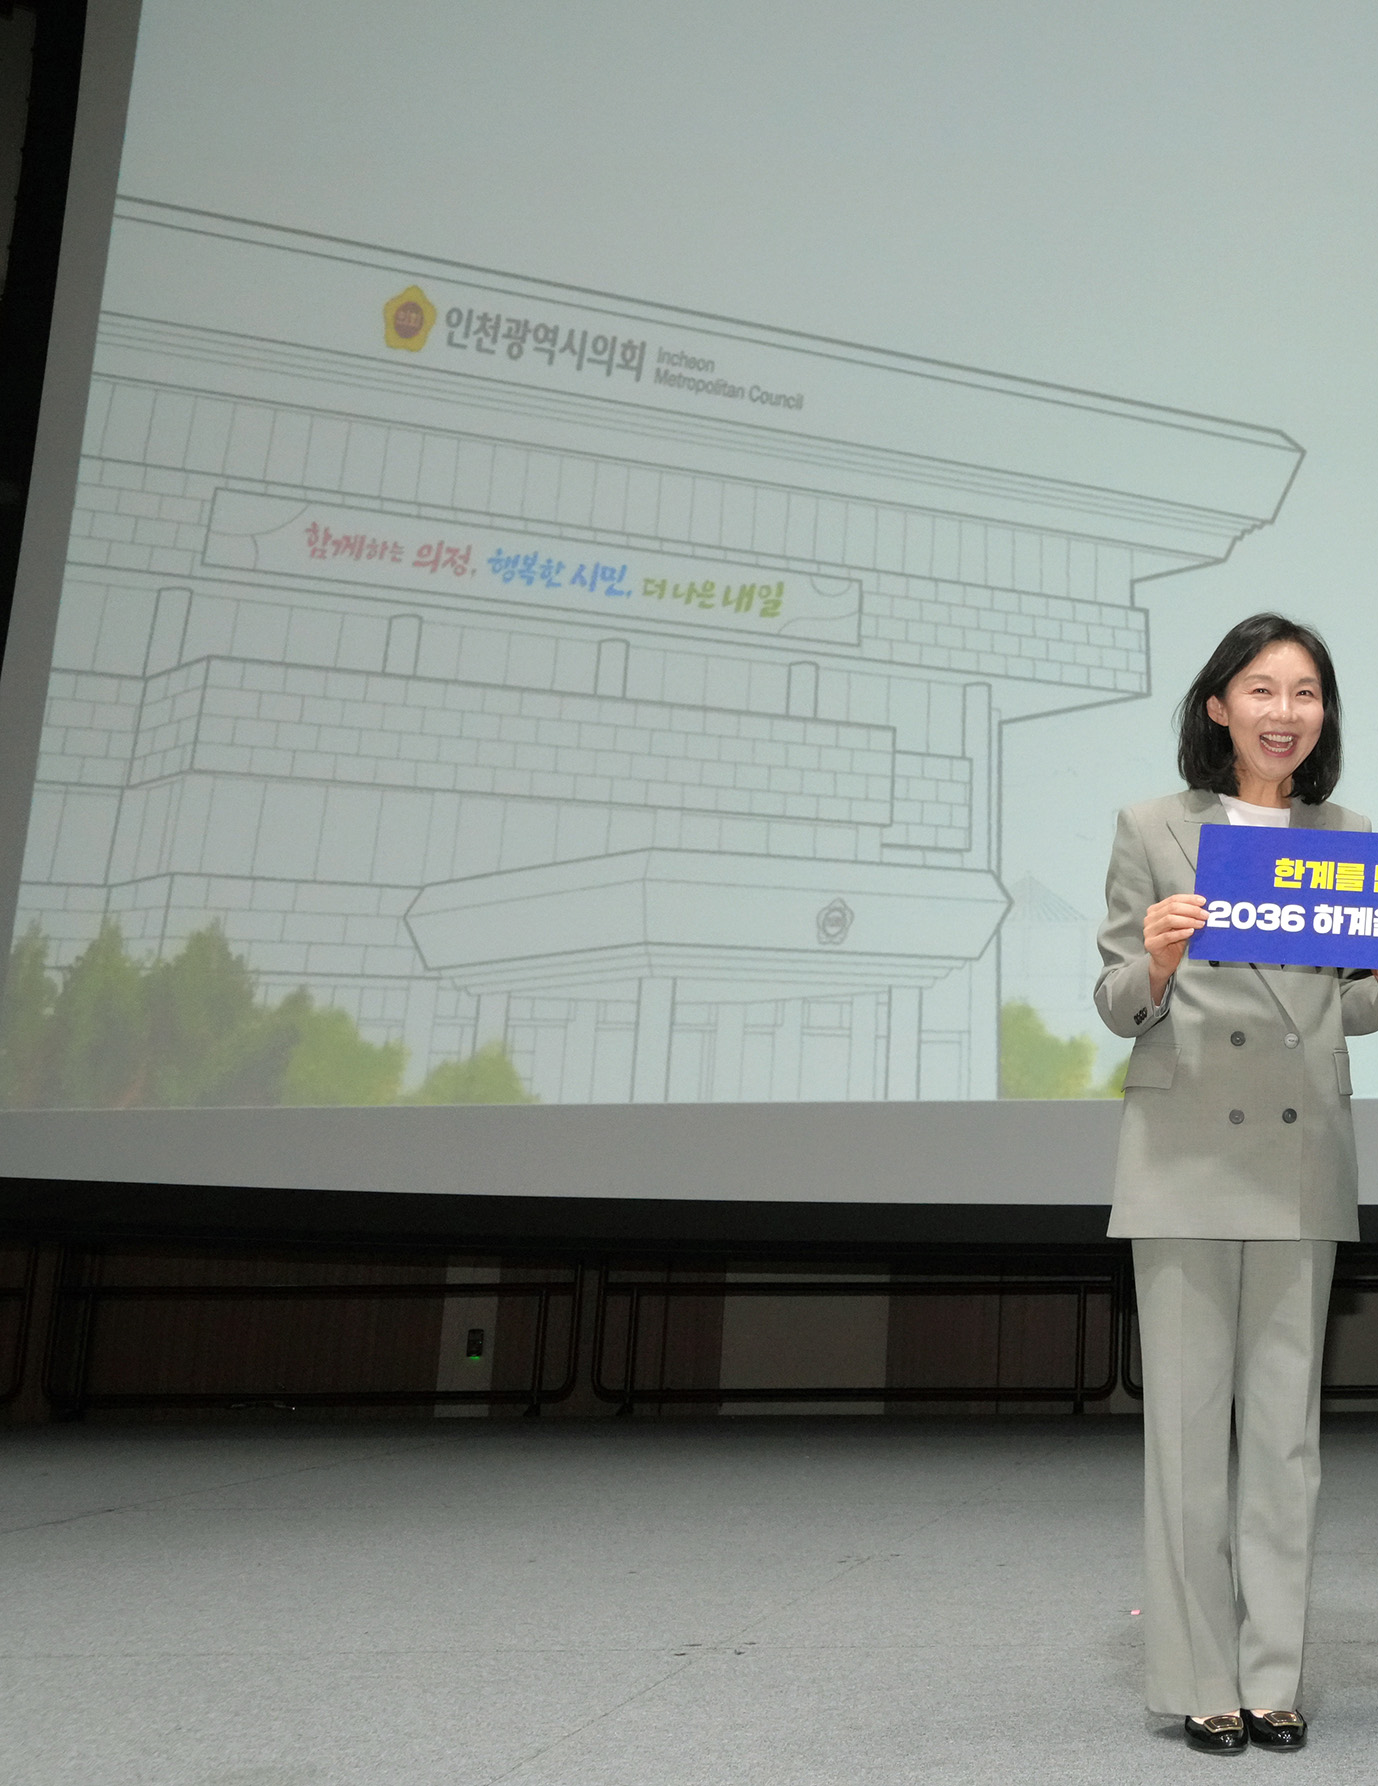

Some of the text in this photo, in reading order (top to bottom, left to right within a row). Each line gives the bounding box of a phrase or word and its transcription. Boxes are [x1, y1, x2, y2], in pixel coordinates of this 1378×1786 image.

[445, 307, 646, 383] 인천광역시의회
[656, 346, 716, 373] Incheon
[654, 367, 805, 411] Metropolitan Council
[305, 521, 404, 563] 함께하는
[487, 547, 566, 590] 행복한
[642, 577, 668, 600] 더
[672, 580, 716, 609] 나은
[722, 580, 785, 618] 내일
[1273, 857, 1364, 891] 한계를
[1207, 900, 1306, 933] 2036
